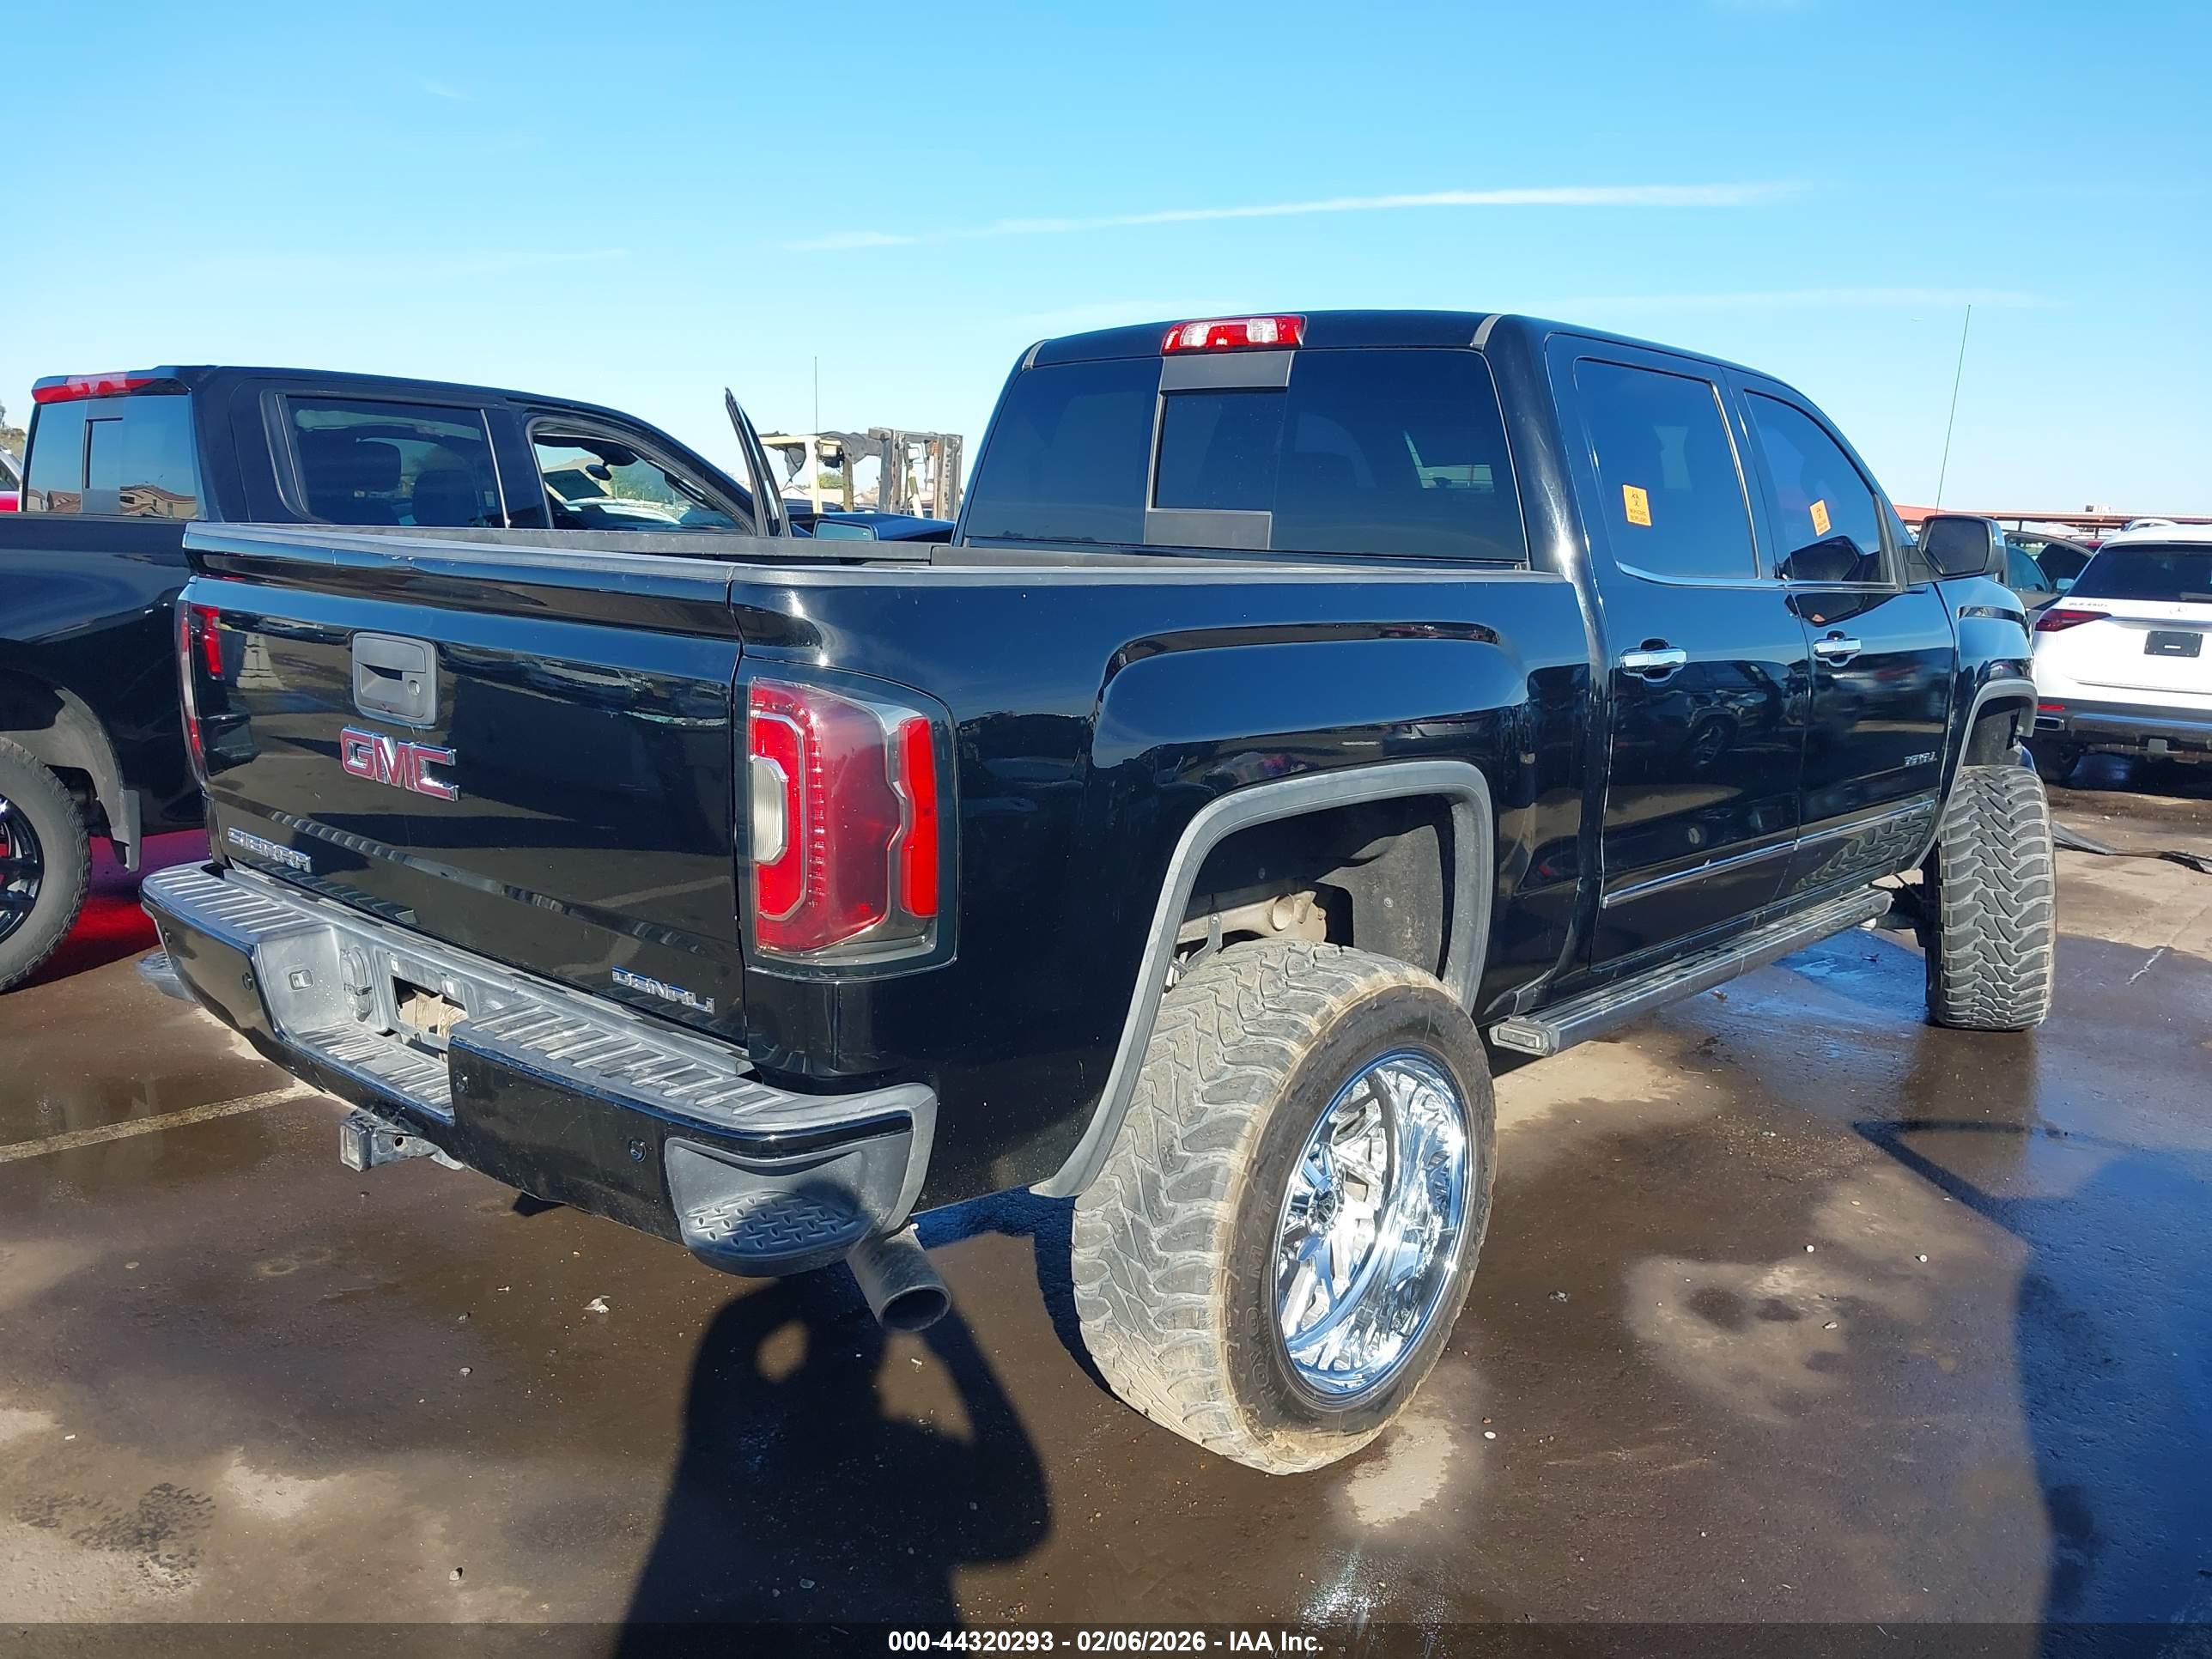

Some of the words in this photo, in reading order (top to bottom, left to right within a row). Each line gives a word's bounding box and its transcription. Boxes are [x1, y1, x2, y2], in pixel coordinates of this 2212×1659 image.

[341, 726, 459, 801] GMC
[228, 827, 312, 872] SIERRA
[611, 966, 715, 1013] DENALI
